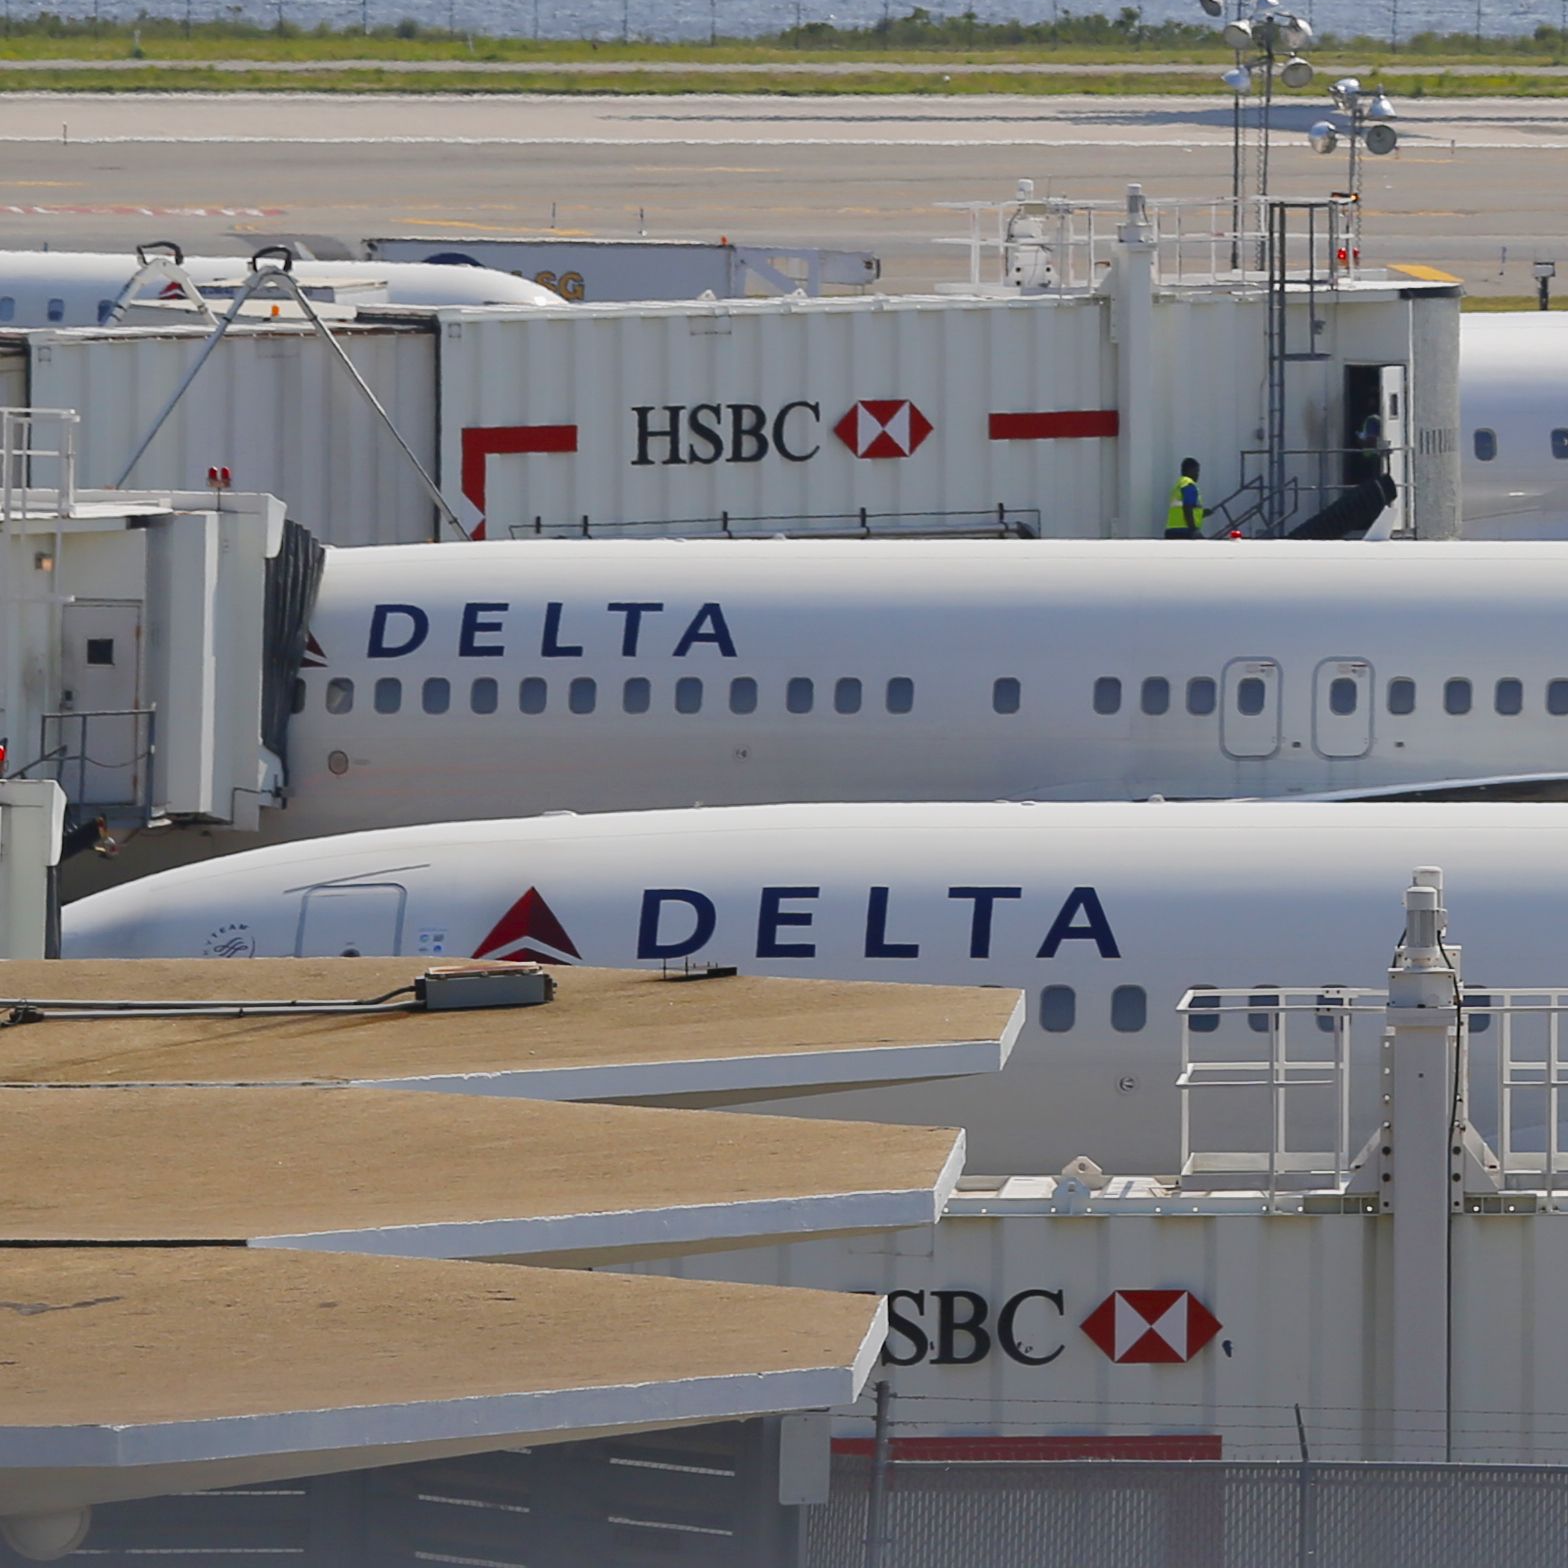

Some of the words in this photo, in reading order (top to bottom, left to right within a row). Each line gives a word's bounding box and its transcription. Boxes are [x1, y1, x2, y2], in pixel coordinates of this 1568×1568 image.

[511, 270, 585, 301] SG
[631, 400, 821, 466] HSBC
[367, 602, 738, 658] DELTA
[637, 886, 1121, 959] DELTA
[850, 1289, 1065, 1366] SBC
